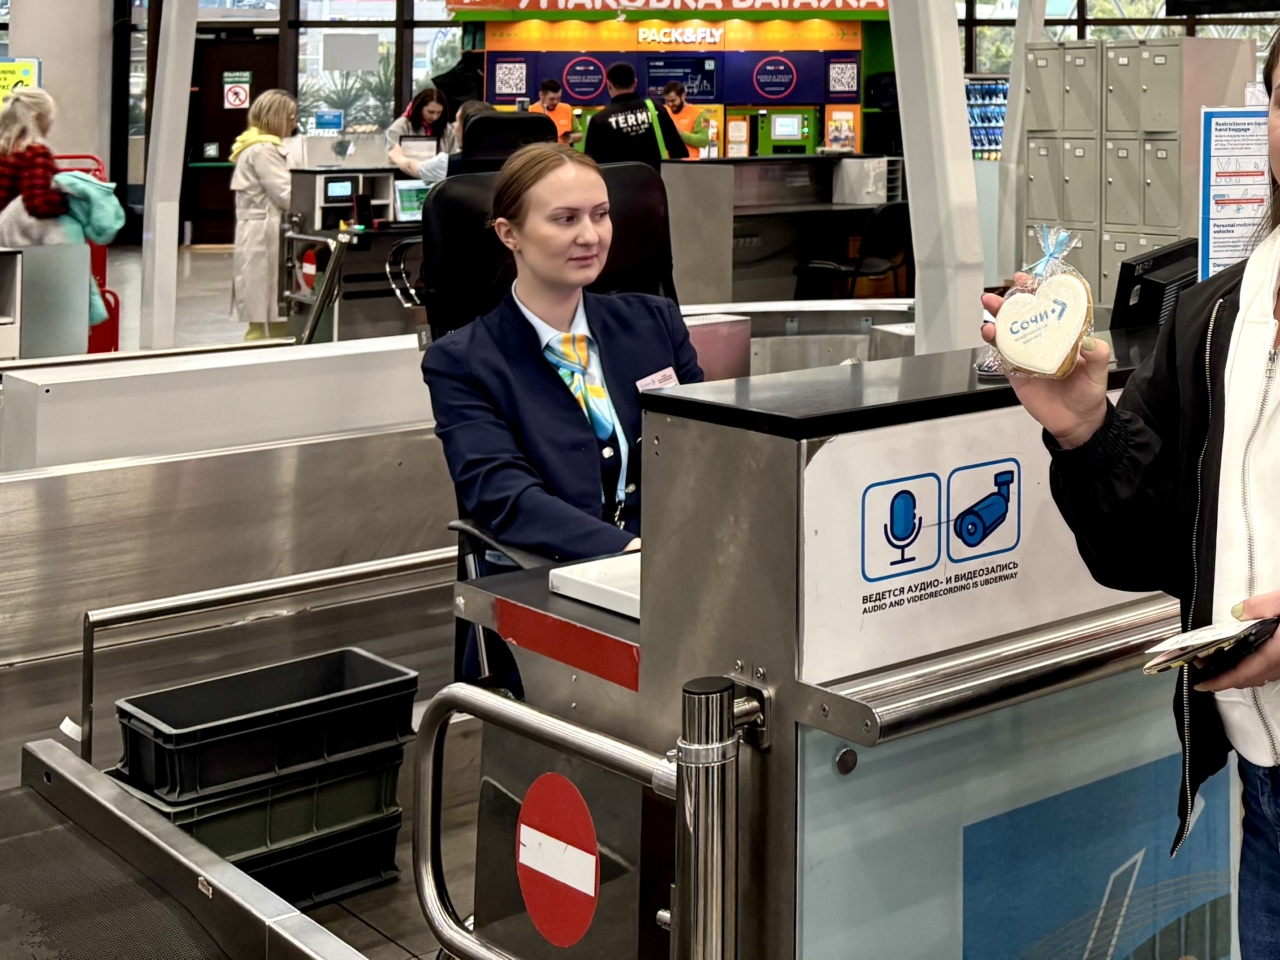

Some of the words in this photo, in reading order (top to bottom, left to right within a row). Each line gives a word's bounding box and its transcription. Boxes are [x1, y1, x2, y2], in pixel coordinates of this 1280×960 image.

[638, 27, 724, 44] PACK&FLY
[1009, 310, 1049, 335] Сочи
[862, 586, 905, 605] ВЕДЕТСЯ
[906, 579, 944, 594] АУДИО-
[945, 576, 952, 585] И
[953, 561, 1019, 583] ВИДЕОЗАПИСЬ
[862, 602, 888, 615] AUDIO
[888, 597, 905, 609] AND
[906, 582, 971, 605] VIDEORECORDING
[972, 581, 979, 589] IS
